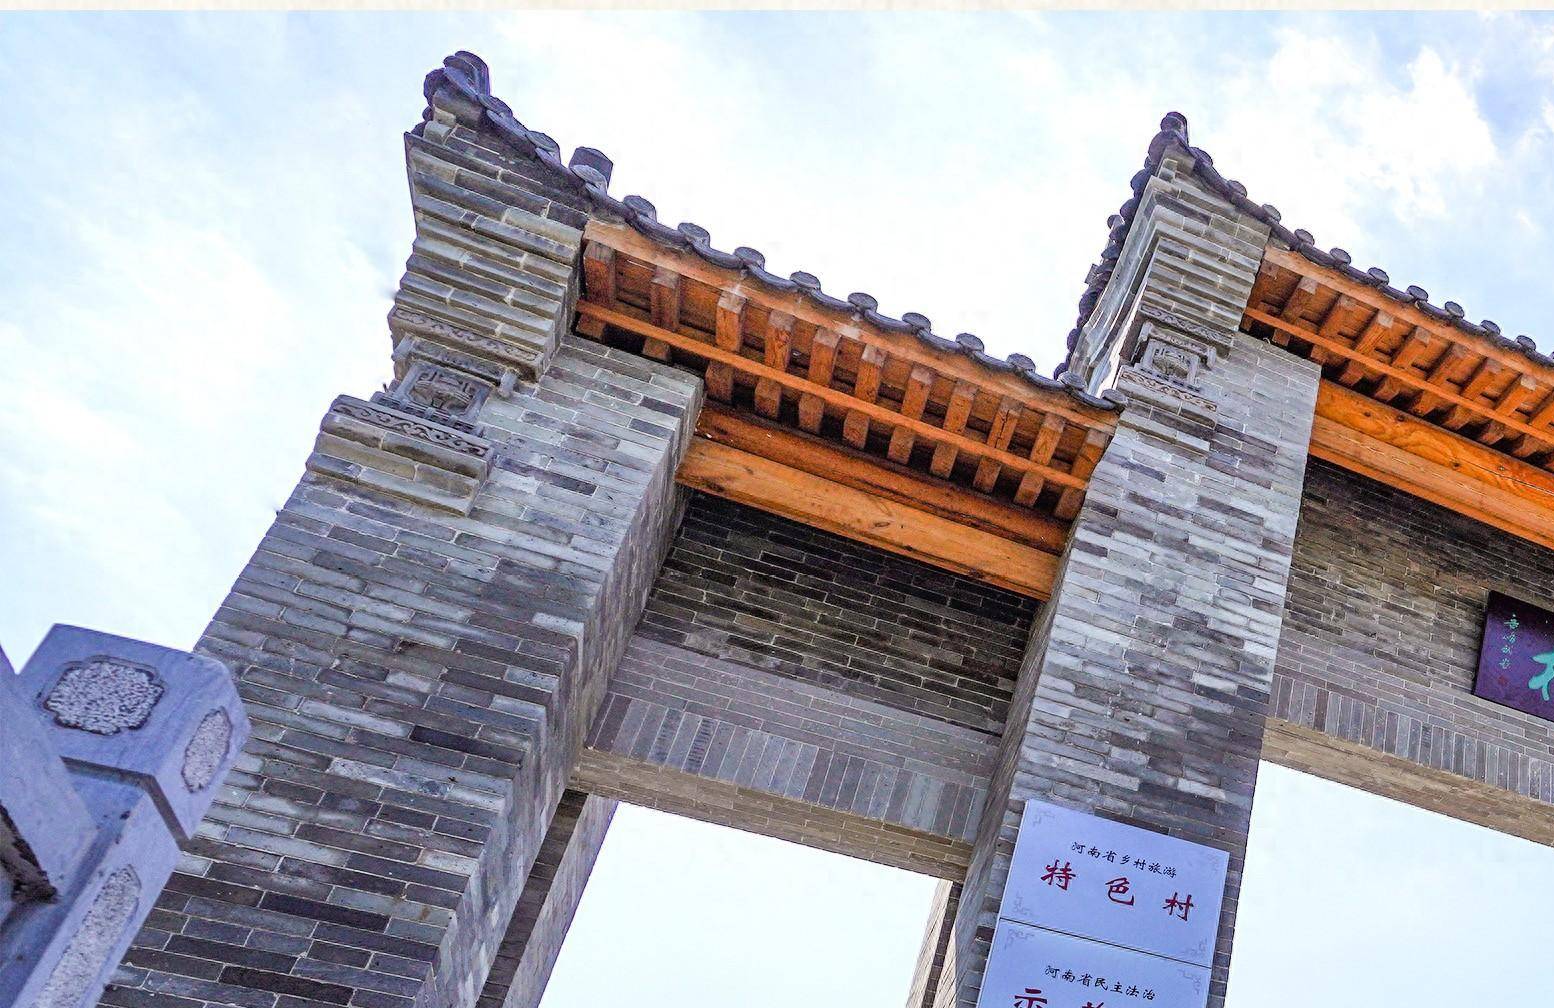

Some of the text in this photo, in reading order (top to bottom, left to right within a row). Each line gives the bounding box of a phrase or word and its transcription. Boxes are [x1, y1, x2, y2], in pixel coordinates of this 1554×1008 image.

[1071, 841, 1177, 879] 河南省乡村旅游
[1040, 858, 1195, 921] 特色村
[1043, 965, 1157, 1001] 河南省民主法治
